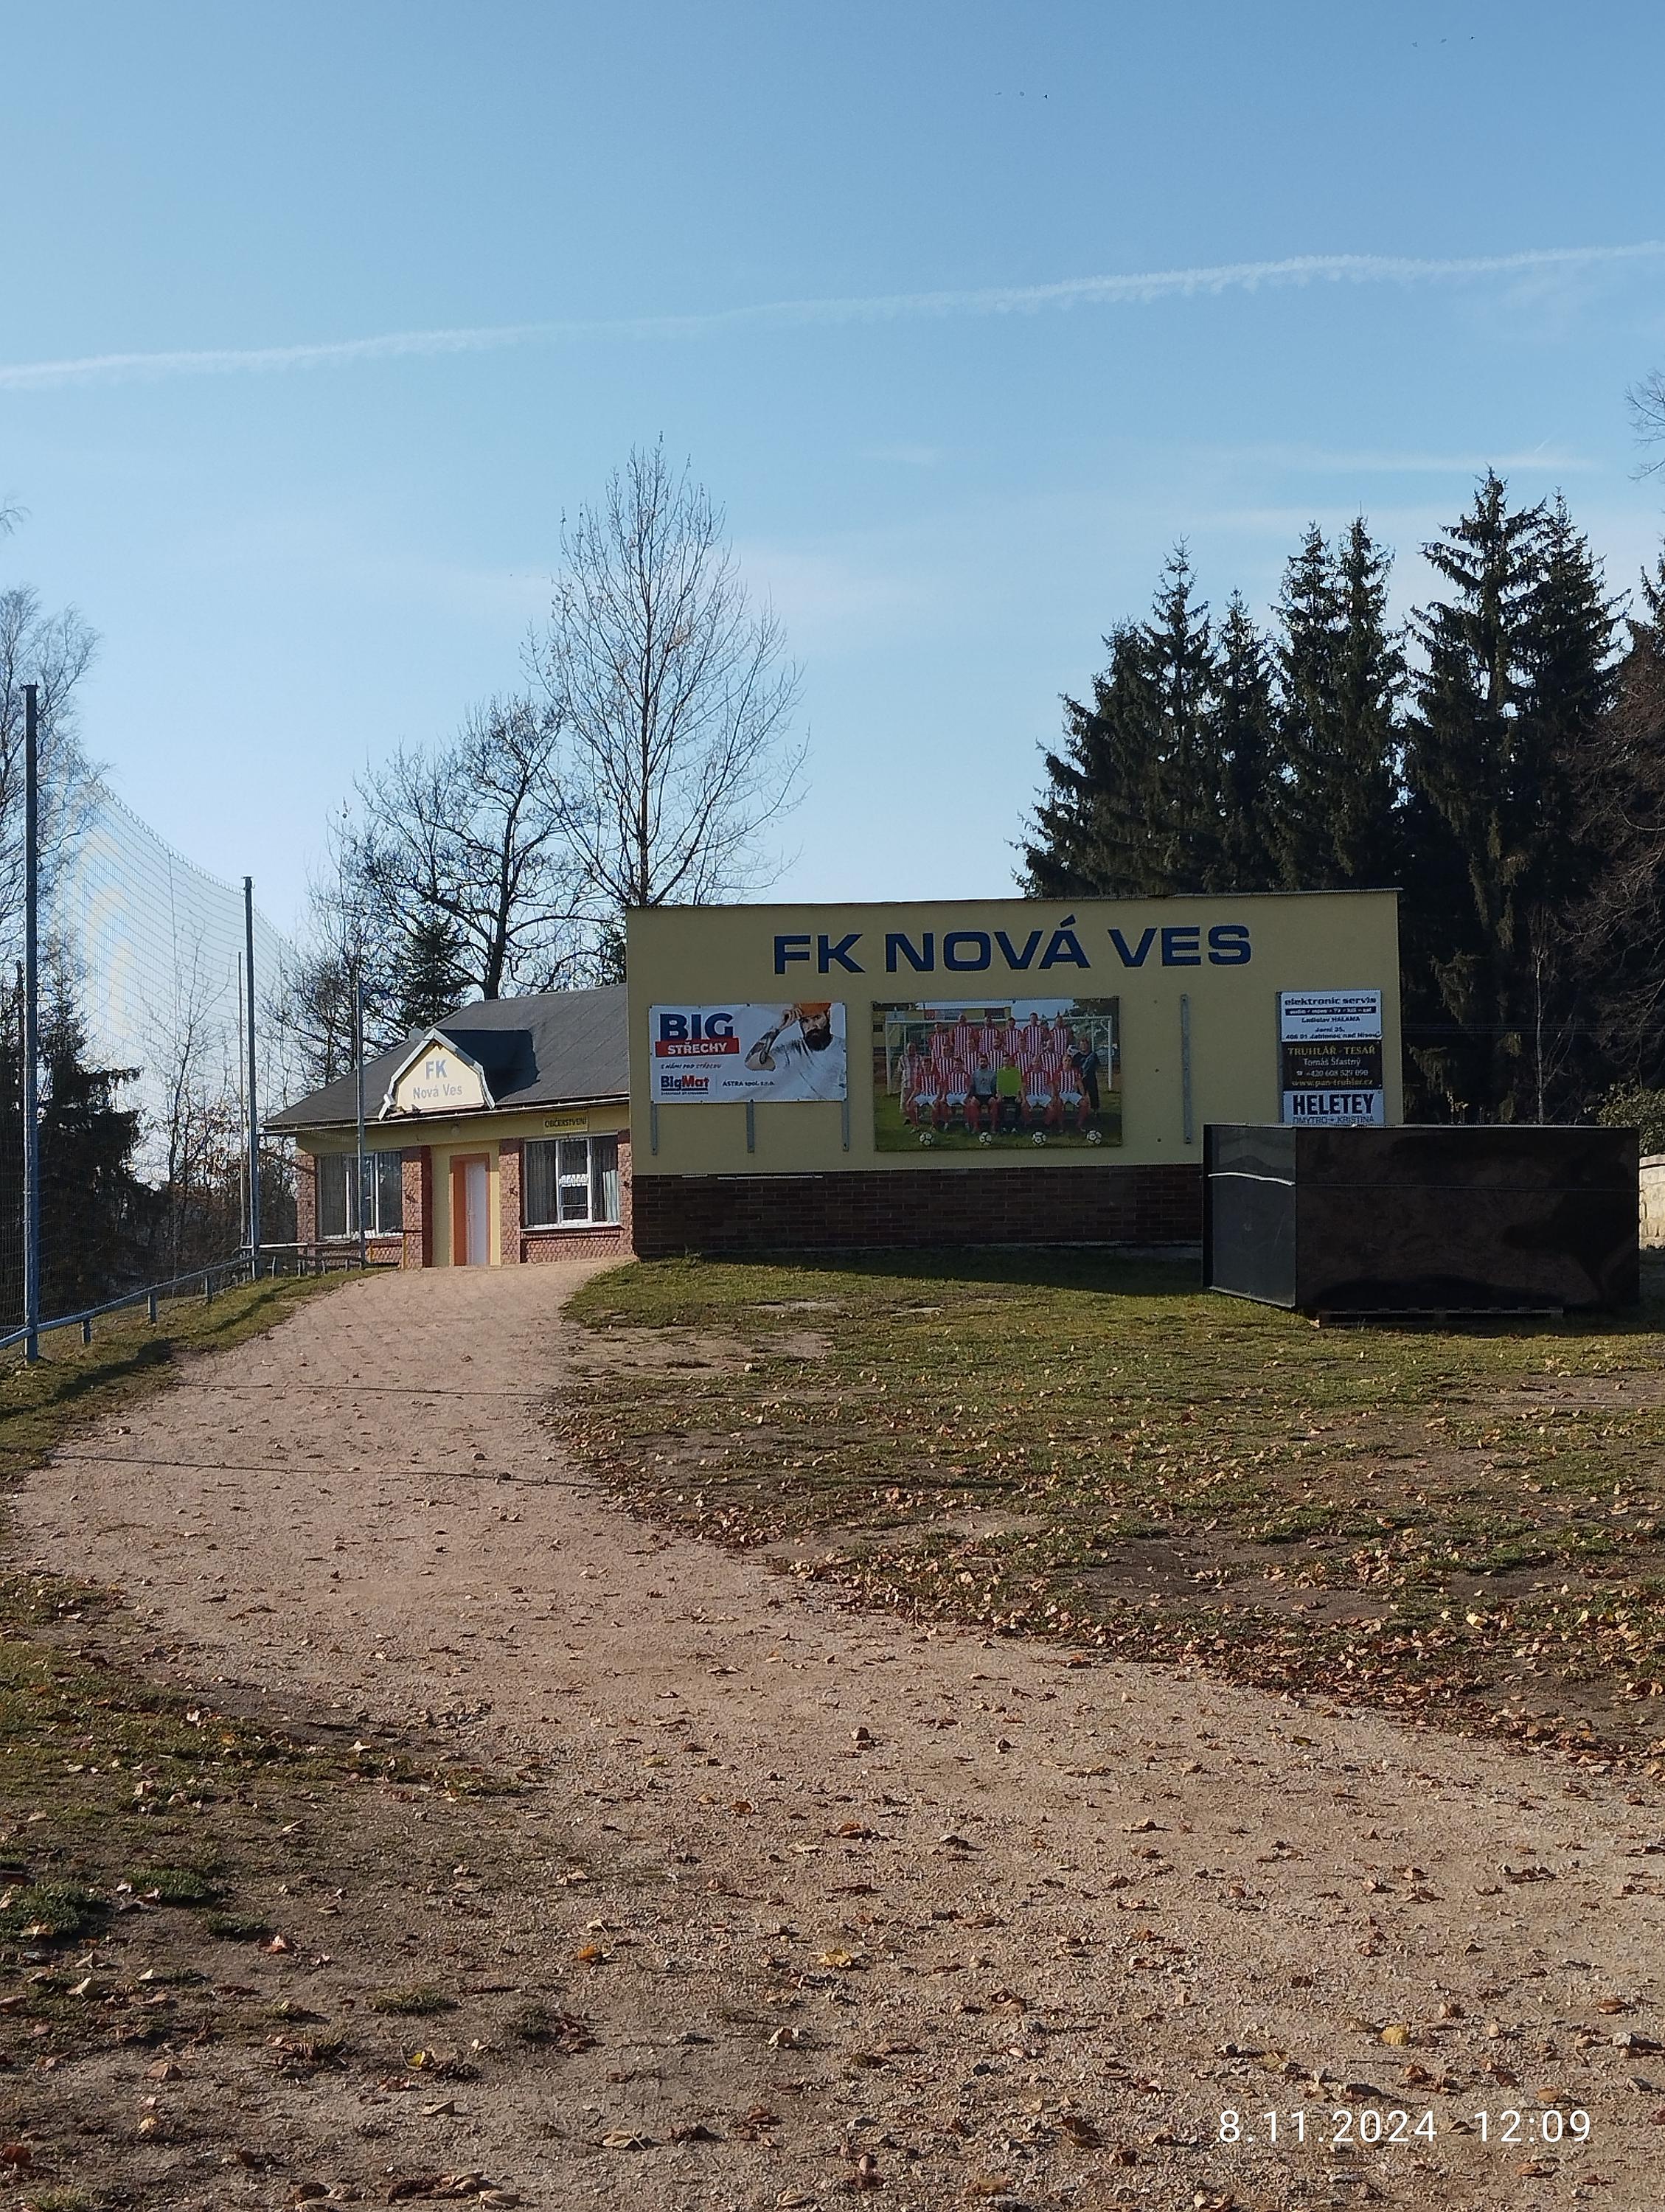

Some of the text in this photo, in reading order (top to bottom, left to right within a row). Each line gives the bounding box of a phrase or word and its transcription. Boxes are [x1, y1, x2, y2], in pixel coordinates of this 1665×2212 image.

[773, 914, 1252, 974] FK NOVÁ VES
[659, 1012, 734, 1040] BIG
[667, 1040, 728, 1054] STŘECHY
[1287, 1045, 1338, 1056] TRUHLÁŘ
[1344, 1044, 1376, 1054] TESAŘ
[425, 1059, 448, 1080] FK
[1304, 1057, 1329, 1066] Tomáš
[661, 1075, 709, 1089] BigMat
[413, 1083, 463, 1100] Nová Ves
[1293, 1093, 1375, 1115] HELETEY
